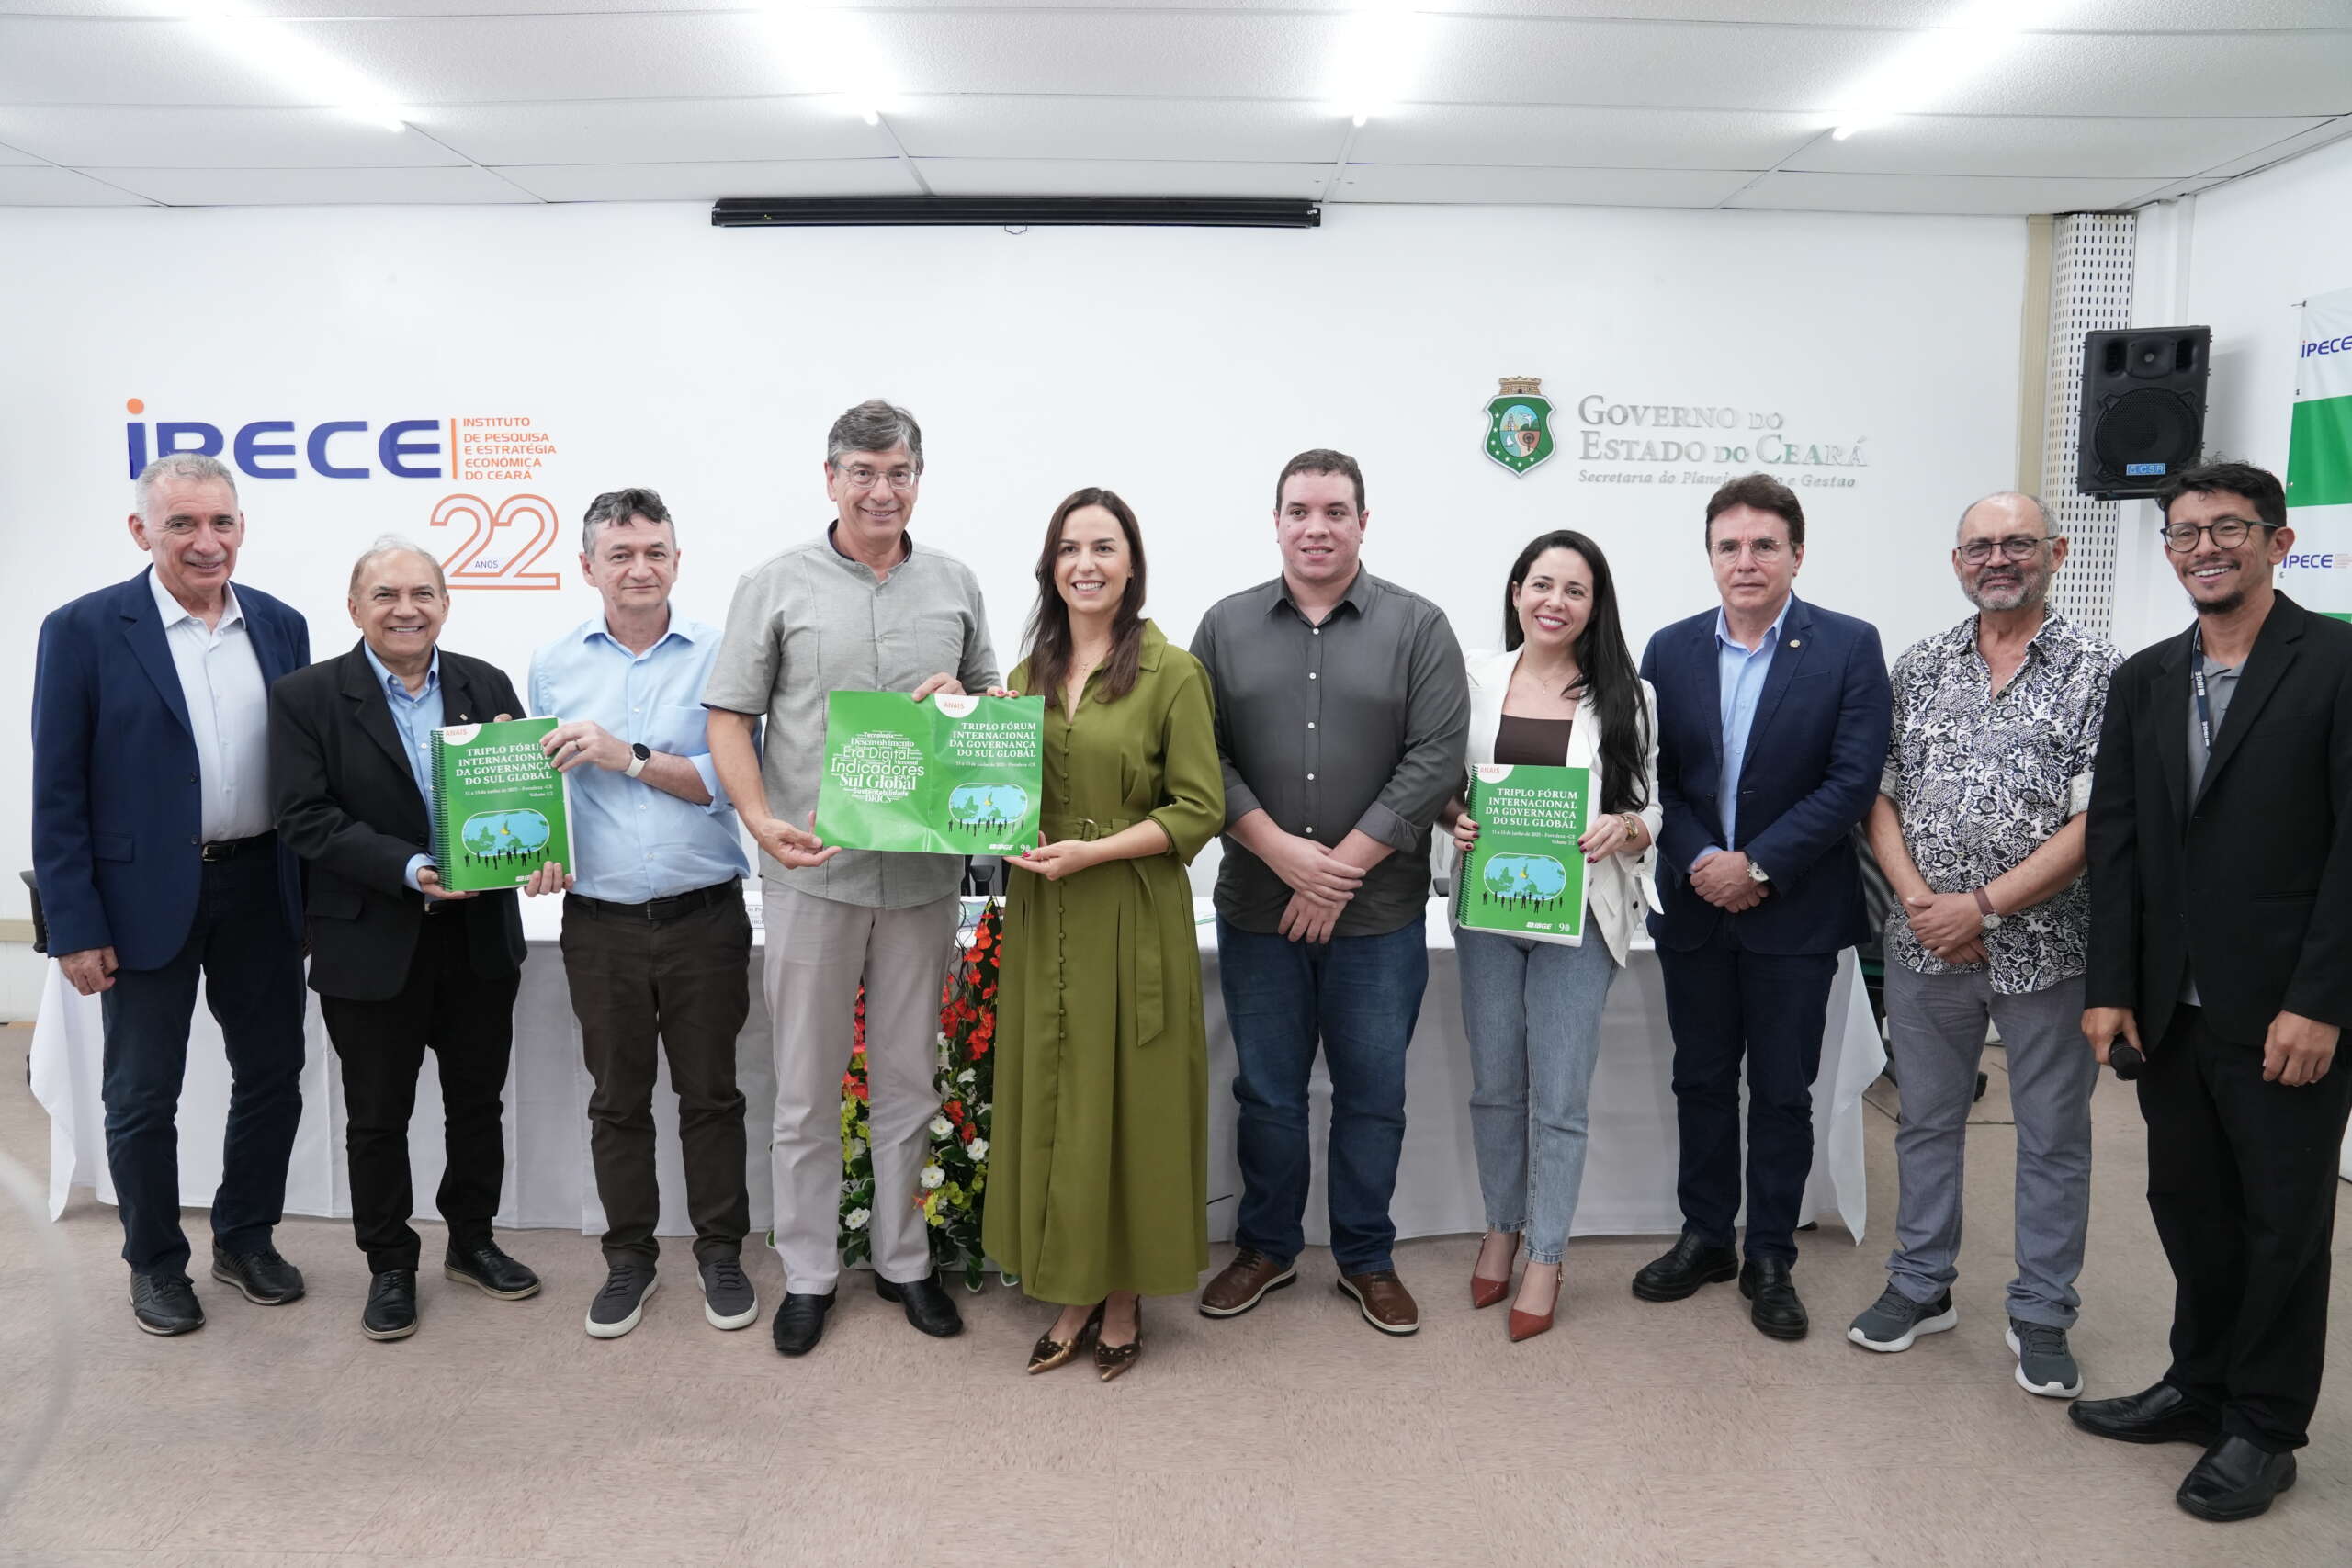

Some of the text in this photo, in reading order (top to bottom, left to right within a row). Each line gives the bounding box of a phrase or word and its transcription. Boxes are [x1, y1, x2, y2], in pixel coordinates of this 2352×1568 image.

[463, 417, 530, 427] INSTITUTO
[464, 433, 549, 443] DE PESQUISA
[465, 443, 557, 455] E ESTRATÉGIA
[465, 457, 542, 468] ECONÔMICA
[466, 468, 533, 480] DO CEARÁ
[430, 493, 560, 590] 22
[474, 559, 499, 569] ANOS
[962, 720, 1036, 730] TRIPLO FÓRUM
[953, 730, 1036, 739] INTERNACIONAL
[466, 745, 506, 757] TRIPLO
[967, 741, 1036, 750] GOVERNANÇA
[458, 752, 551, 767] INTERNACIONAL
[843, 745, 865, 758] Era
[869, 747, 910, 762] Digital
[957, 749, 1036, 758] DO SUL GLOBAL
[456, 761, 551, 777] DA GOVERNANÇA
[831, 757, 925, 776] Indicadores
[465, 771, 552, 785] DO SUL GLOBAL
[839, 773, 916, 790] Sul Global
[1498, 787, 1577, 799] TRIPLO FÓRUM
[1488, 796, 1577, 809] INTERNACIONAL
[1485, 807, 1576, 820] DA GOVERNANÇA
[1493, 817, 1577, 829] DO SUL GLOBAL
